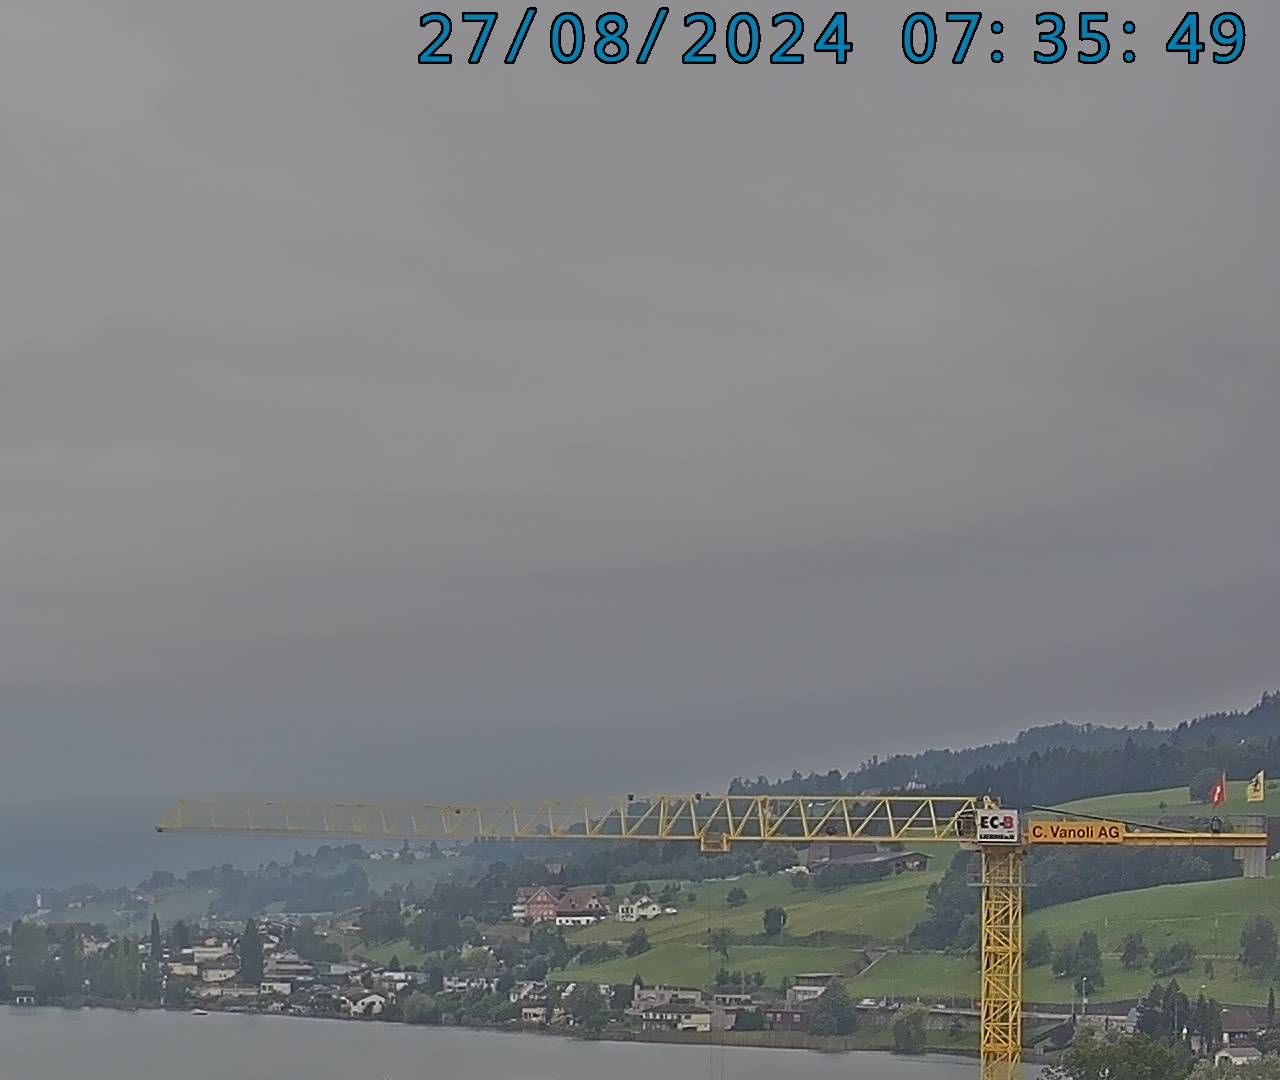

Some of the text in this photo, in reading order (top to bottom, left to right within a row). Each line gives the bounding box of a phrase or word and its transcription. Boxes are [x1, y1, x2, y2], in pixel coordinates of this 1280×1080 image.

[980, 815, 1014, 829] EC-B
[1032, 825, 1120, 838] C. Vanoli AG
